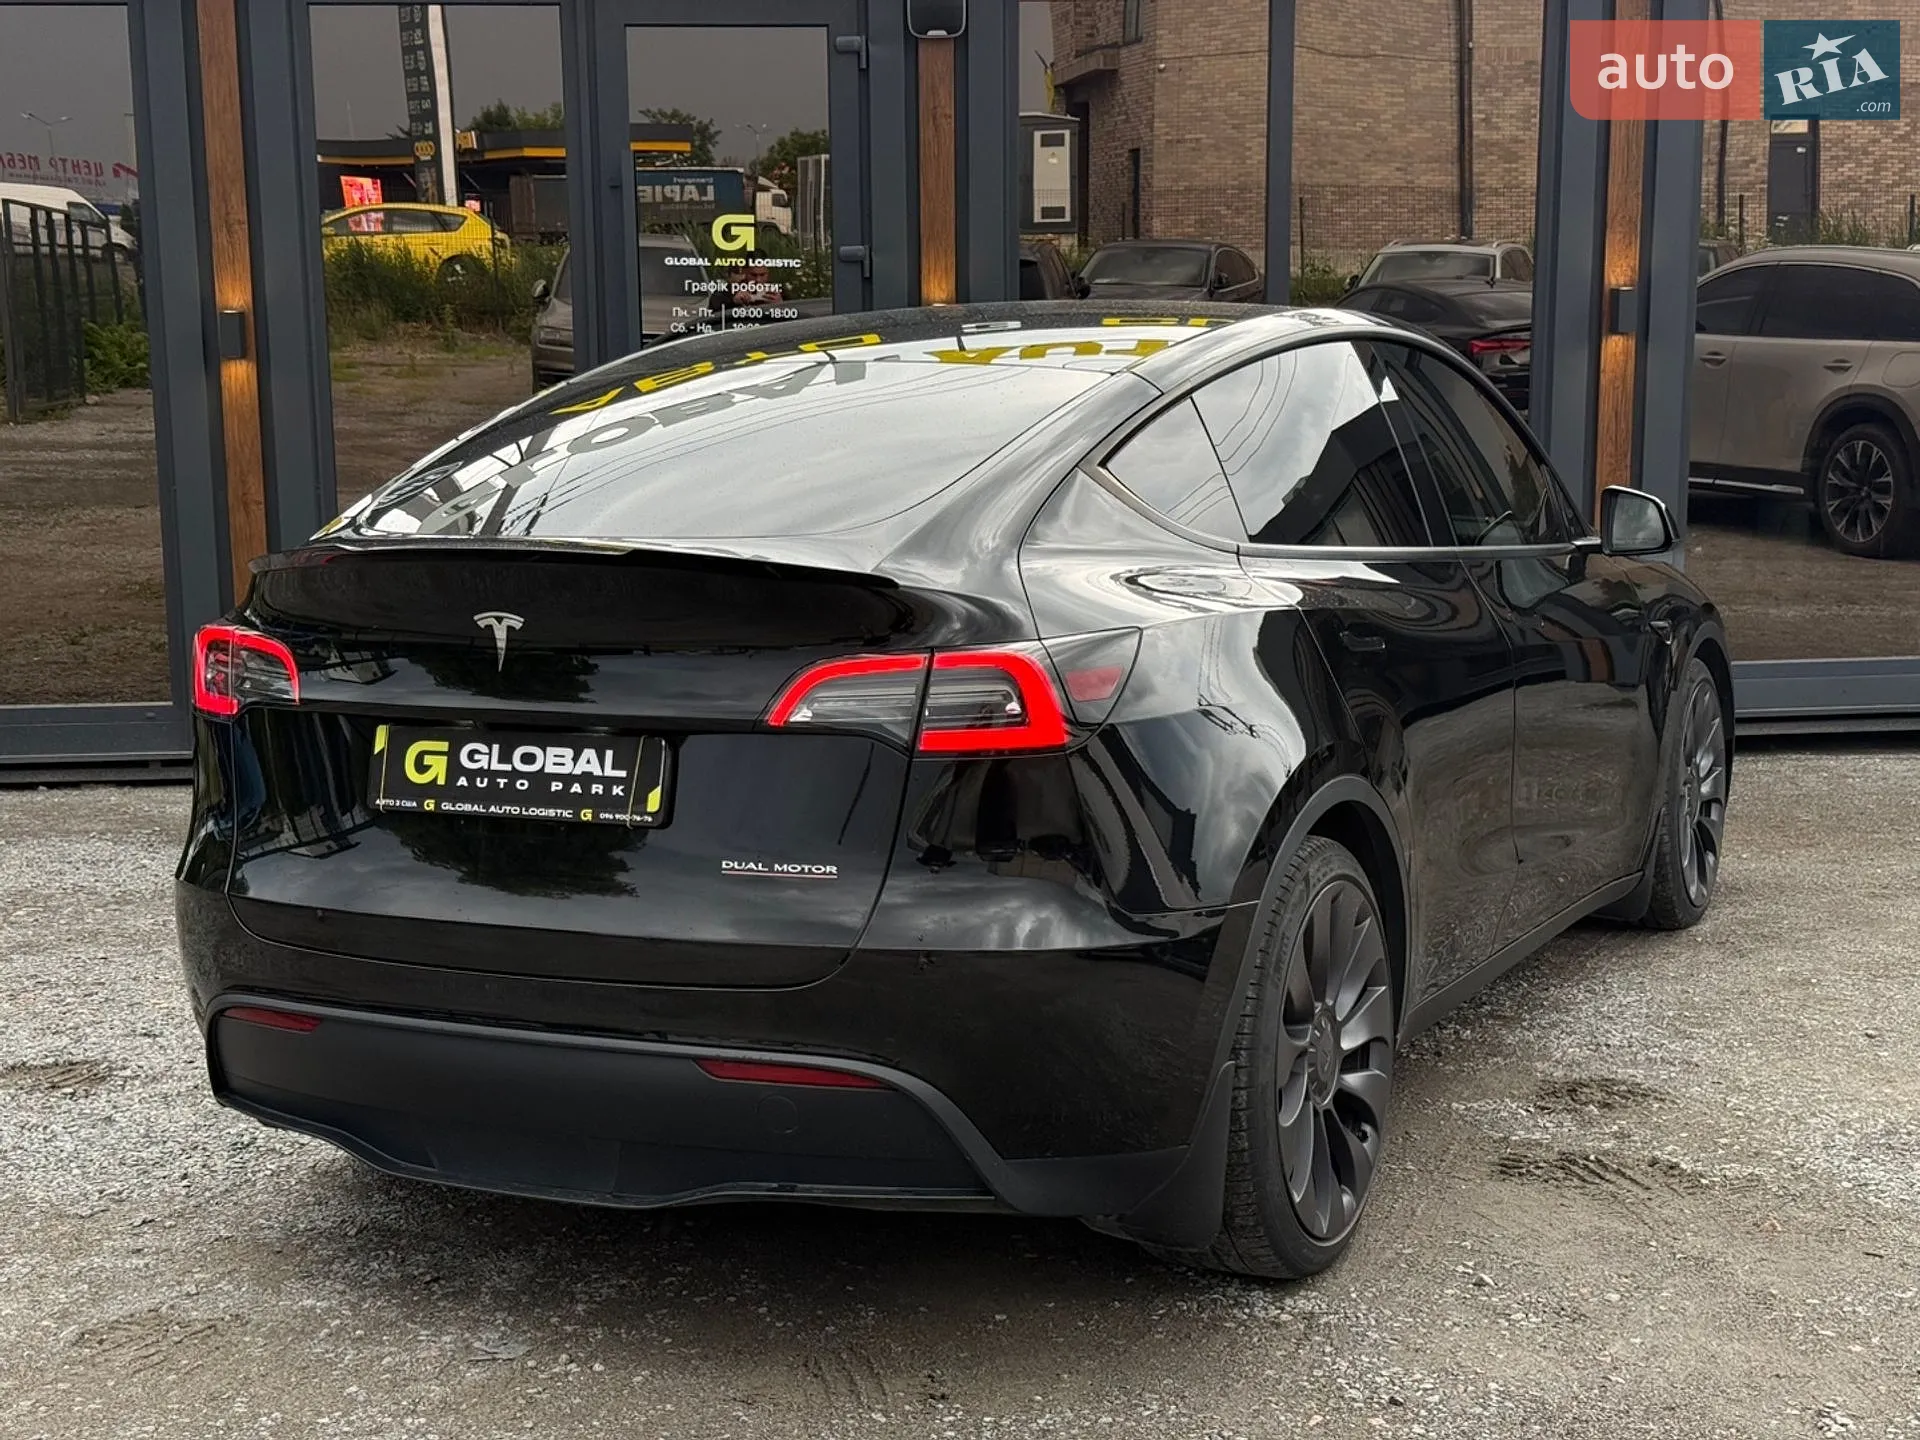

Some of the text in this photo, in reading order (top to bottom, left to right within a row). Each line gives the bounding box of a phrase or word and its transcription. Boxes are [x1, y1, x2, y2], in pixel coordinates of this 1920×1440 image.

[664, 257, 801, 268] GLOBAL AUTO LOGISTIC
[731, 280, 783, 293] роботи:
[731, 307, 763, 318] 09:00
[459, 742, 627, 777] GLOBAL
[456, 776, 625, 796] AUTO PARK
[441, 802, 573, 818] GLOBAL AUTO LOGISTIC
[722, 860, 837, 874] DUAL MOTOR
